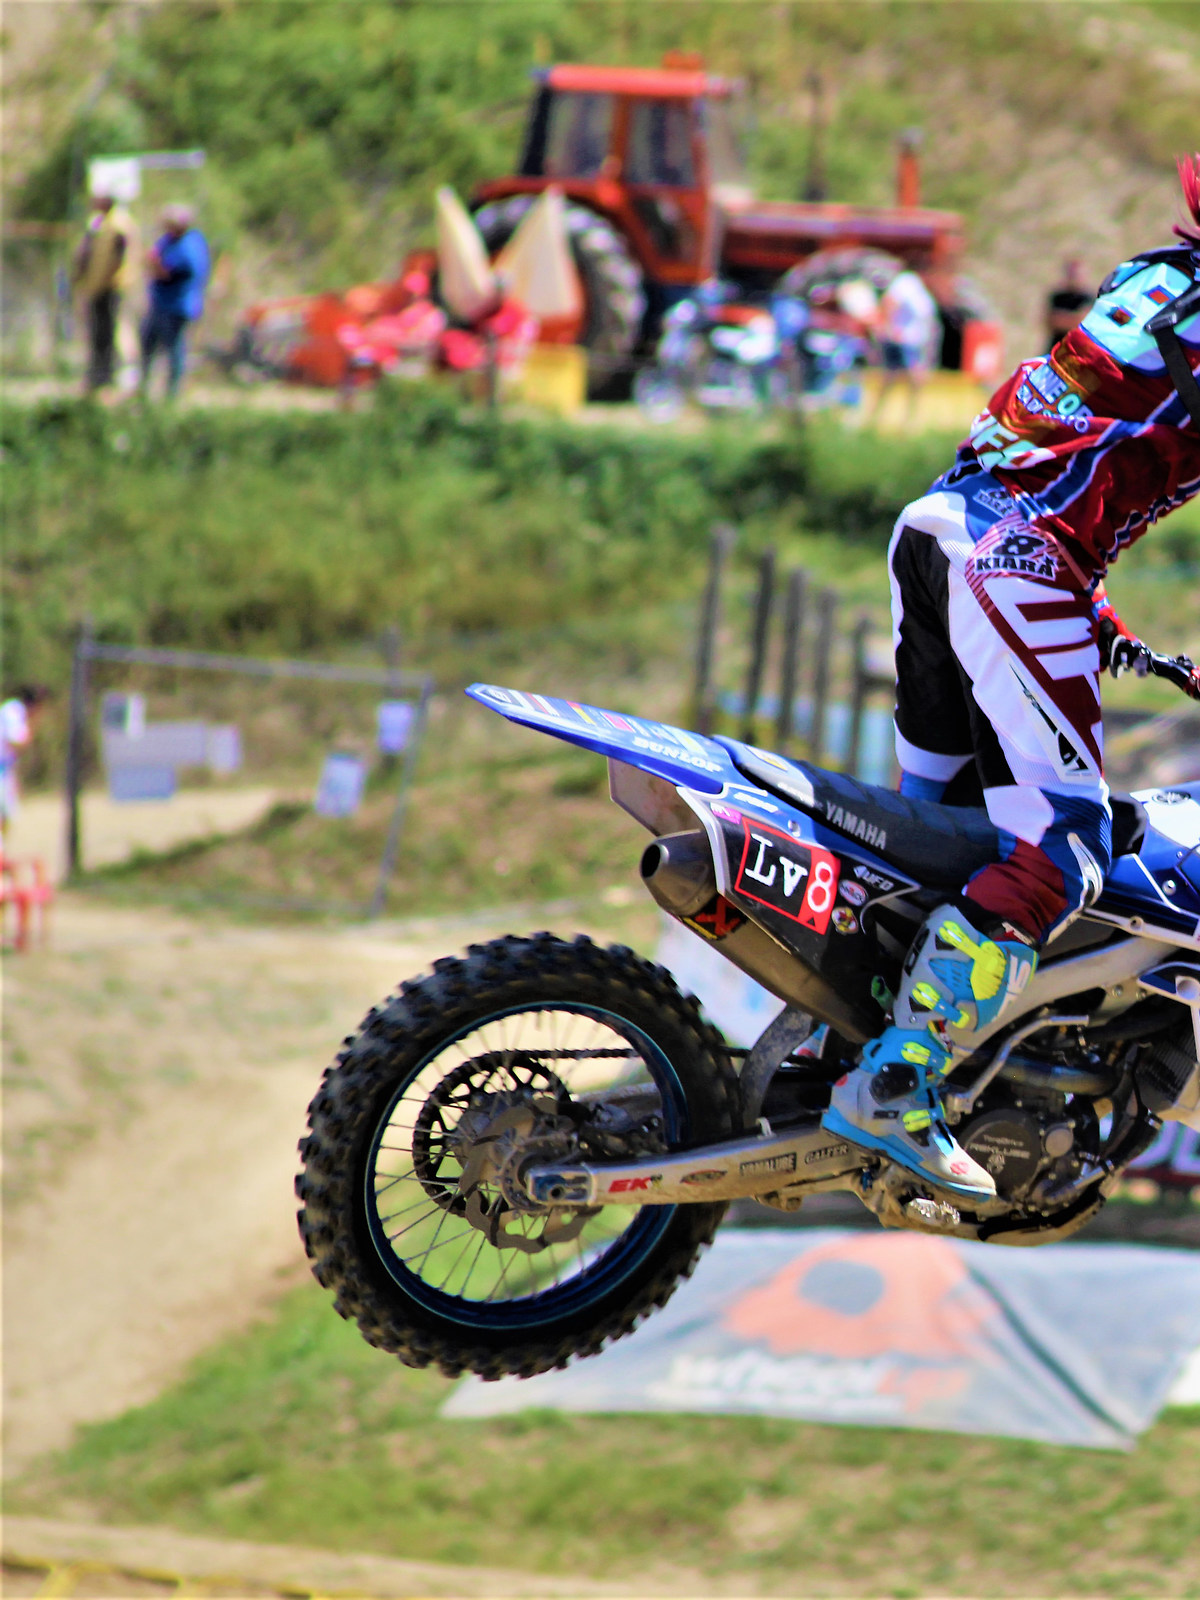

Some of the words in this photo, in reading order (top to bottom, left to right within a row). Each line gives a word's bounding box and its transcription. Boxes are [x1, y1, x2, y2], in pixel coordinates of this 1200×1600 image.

[974, 552, 1058, 580] KIARA
[632, 735, 724, 773] DUNLOP
[825, 800, 887, 850] YAMAHA
[861, 871, 894, 892] UFO
